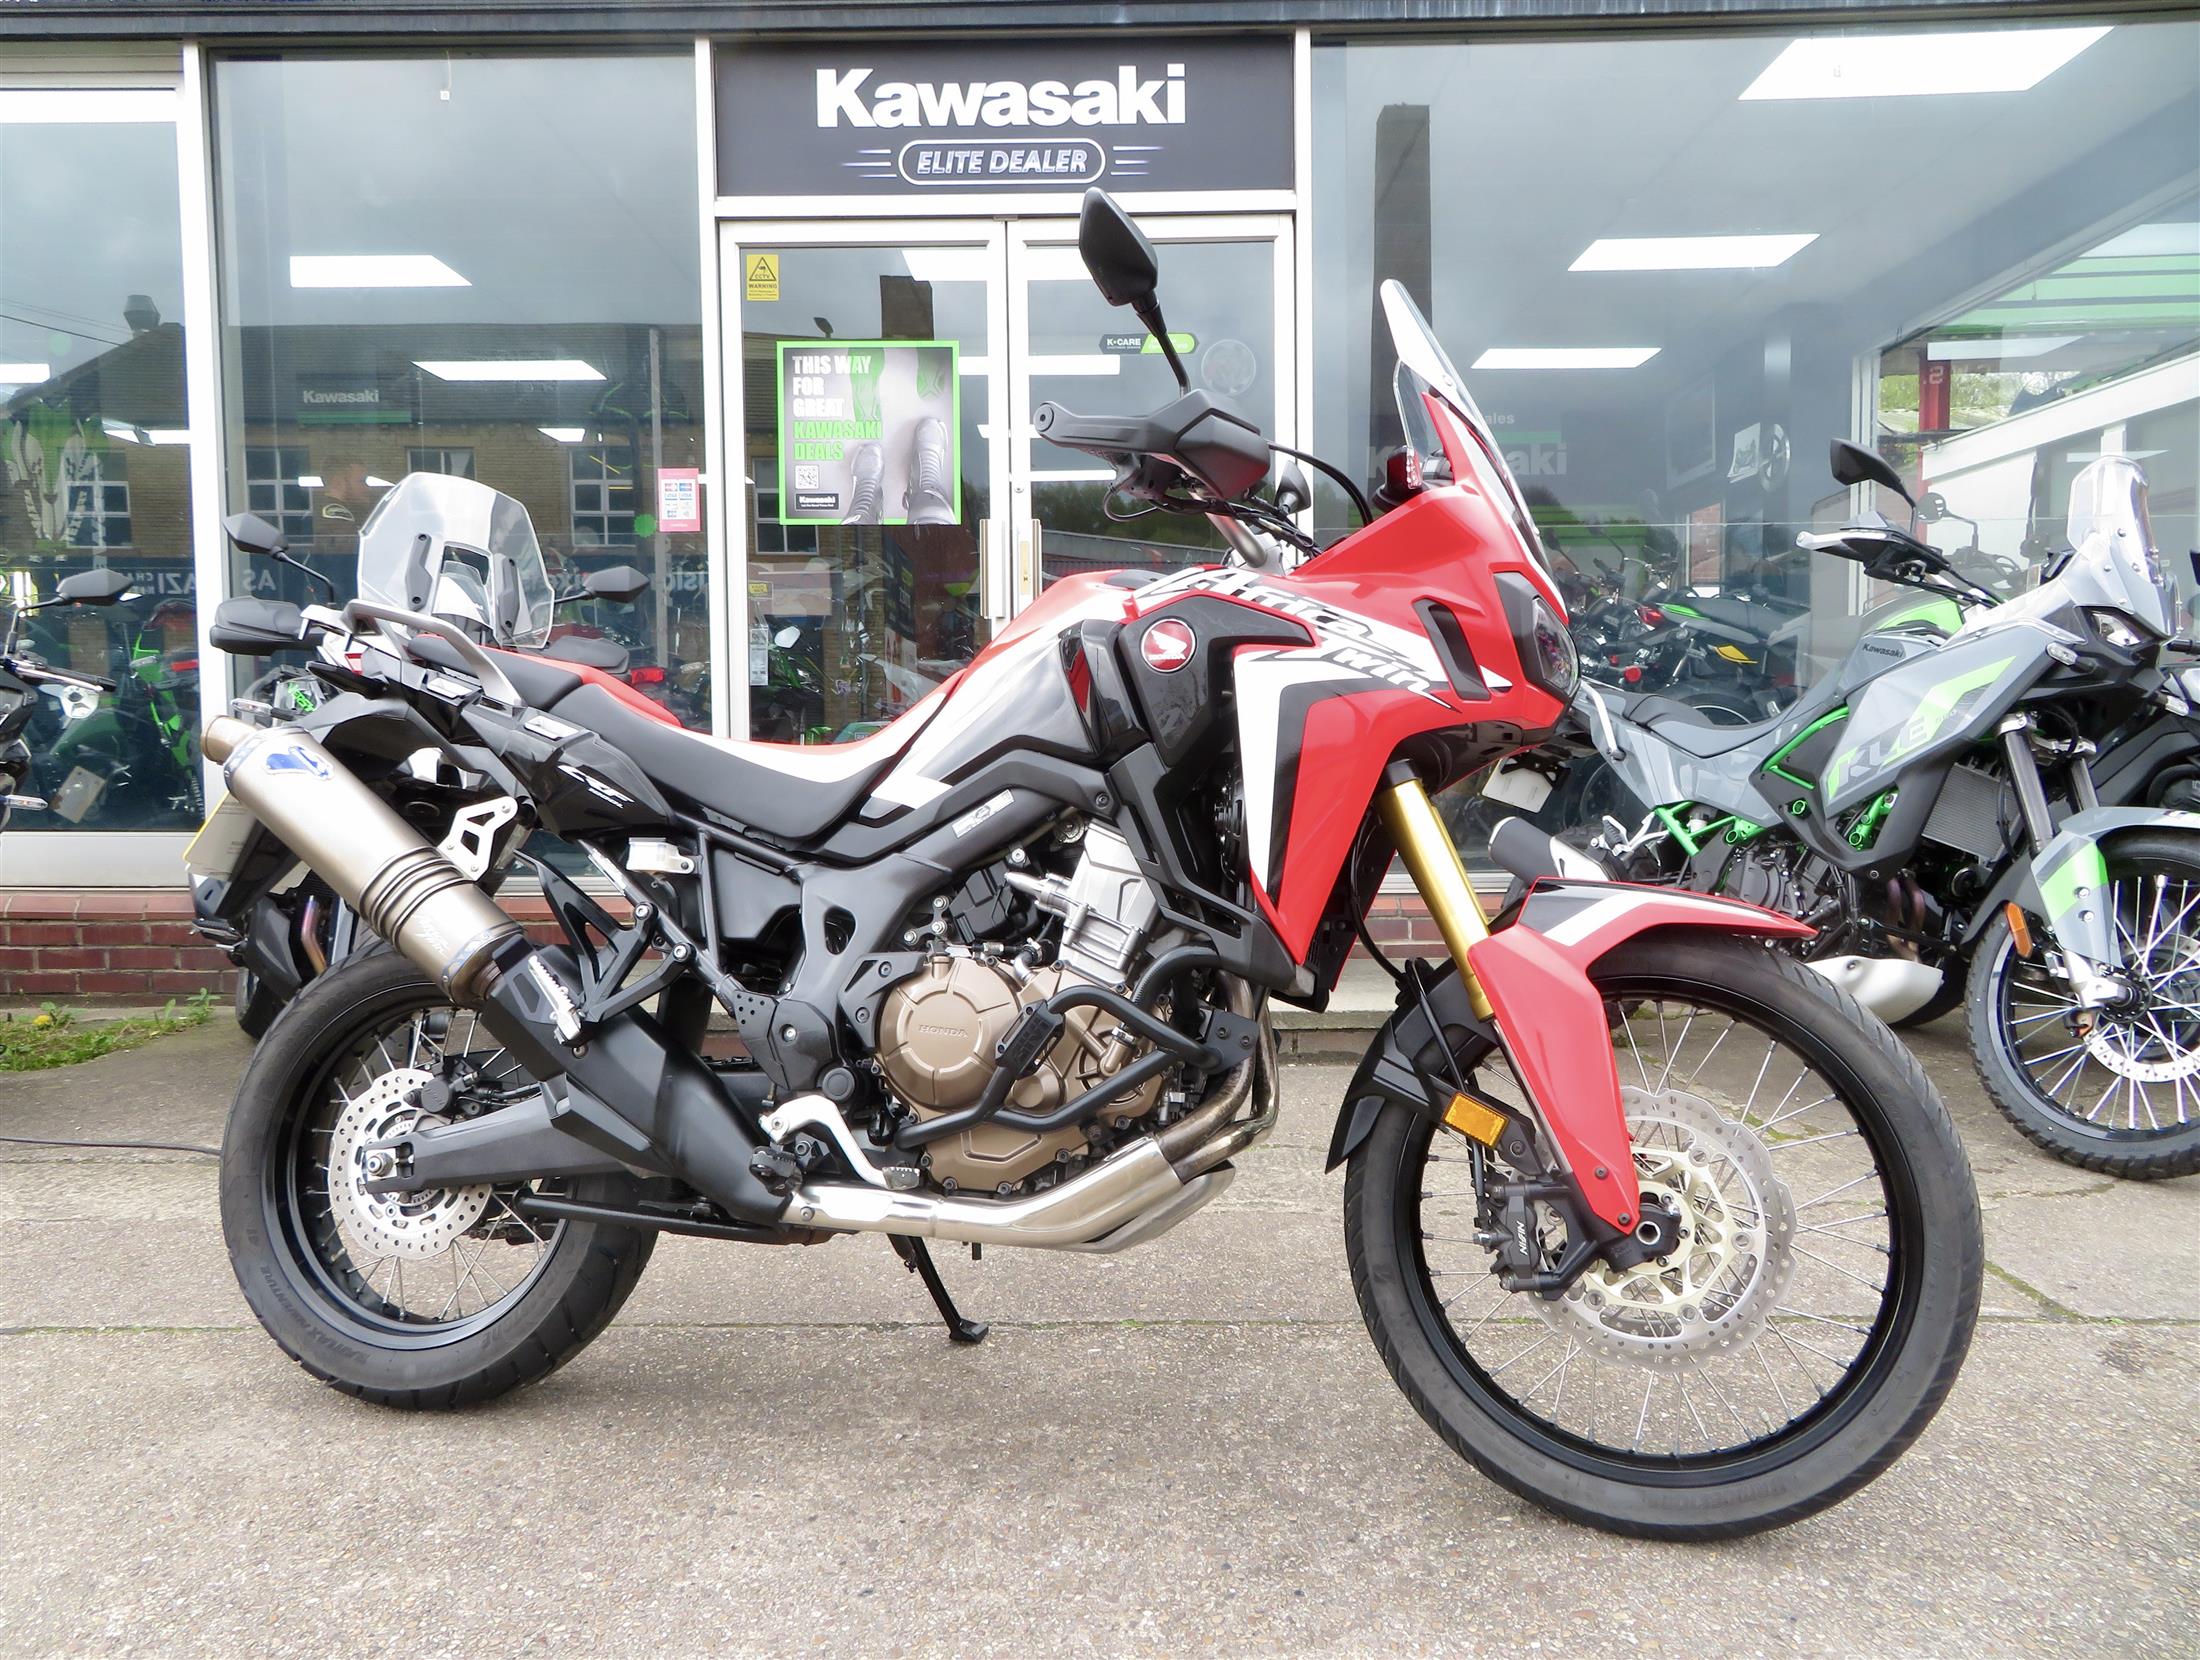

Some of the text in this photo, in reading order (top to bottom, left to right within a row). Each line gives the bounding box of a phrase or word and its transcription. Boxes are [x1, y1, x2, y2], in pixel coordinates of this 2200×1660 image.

[816, 63, 1186, 128] Kawasaki
[917, 150, 1088, 174] ELITE DEALER
[792, 355, 871, 375] THIS WAY
[303, 389, 380, 403] Kawasaki
[792, 377, 825, 396] FOR
[793, 398, 845, 417] GREAT
[793, 420, 882, 440] KAWASAKI
[793, 442, 844, 461] DEALS
[1862, 642, 1905, 659] Kawasaki
[1838, 715, 1928, 785] KLE
[919, 1023, 969, 1040] HONDA
